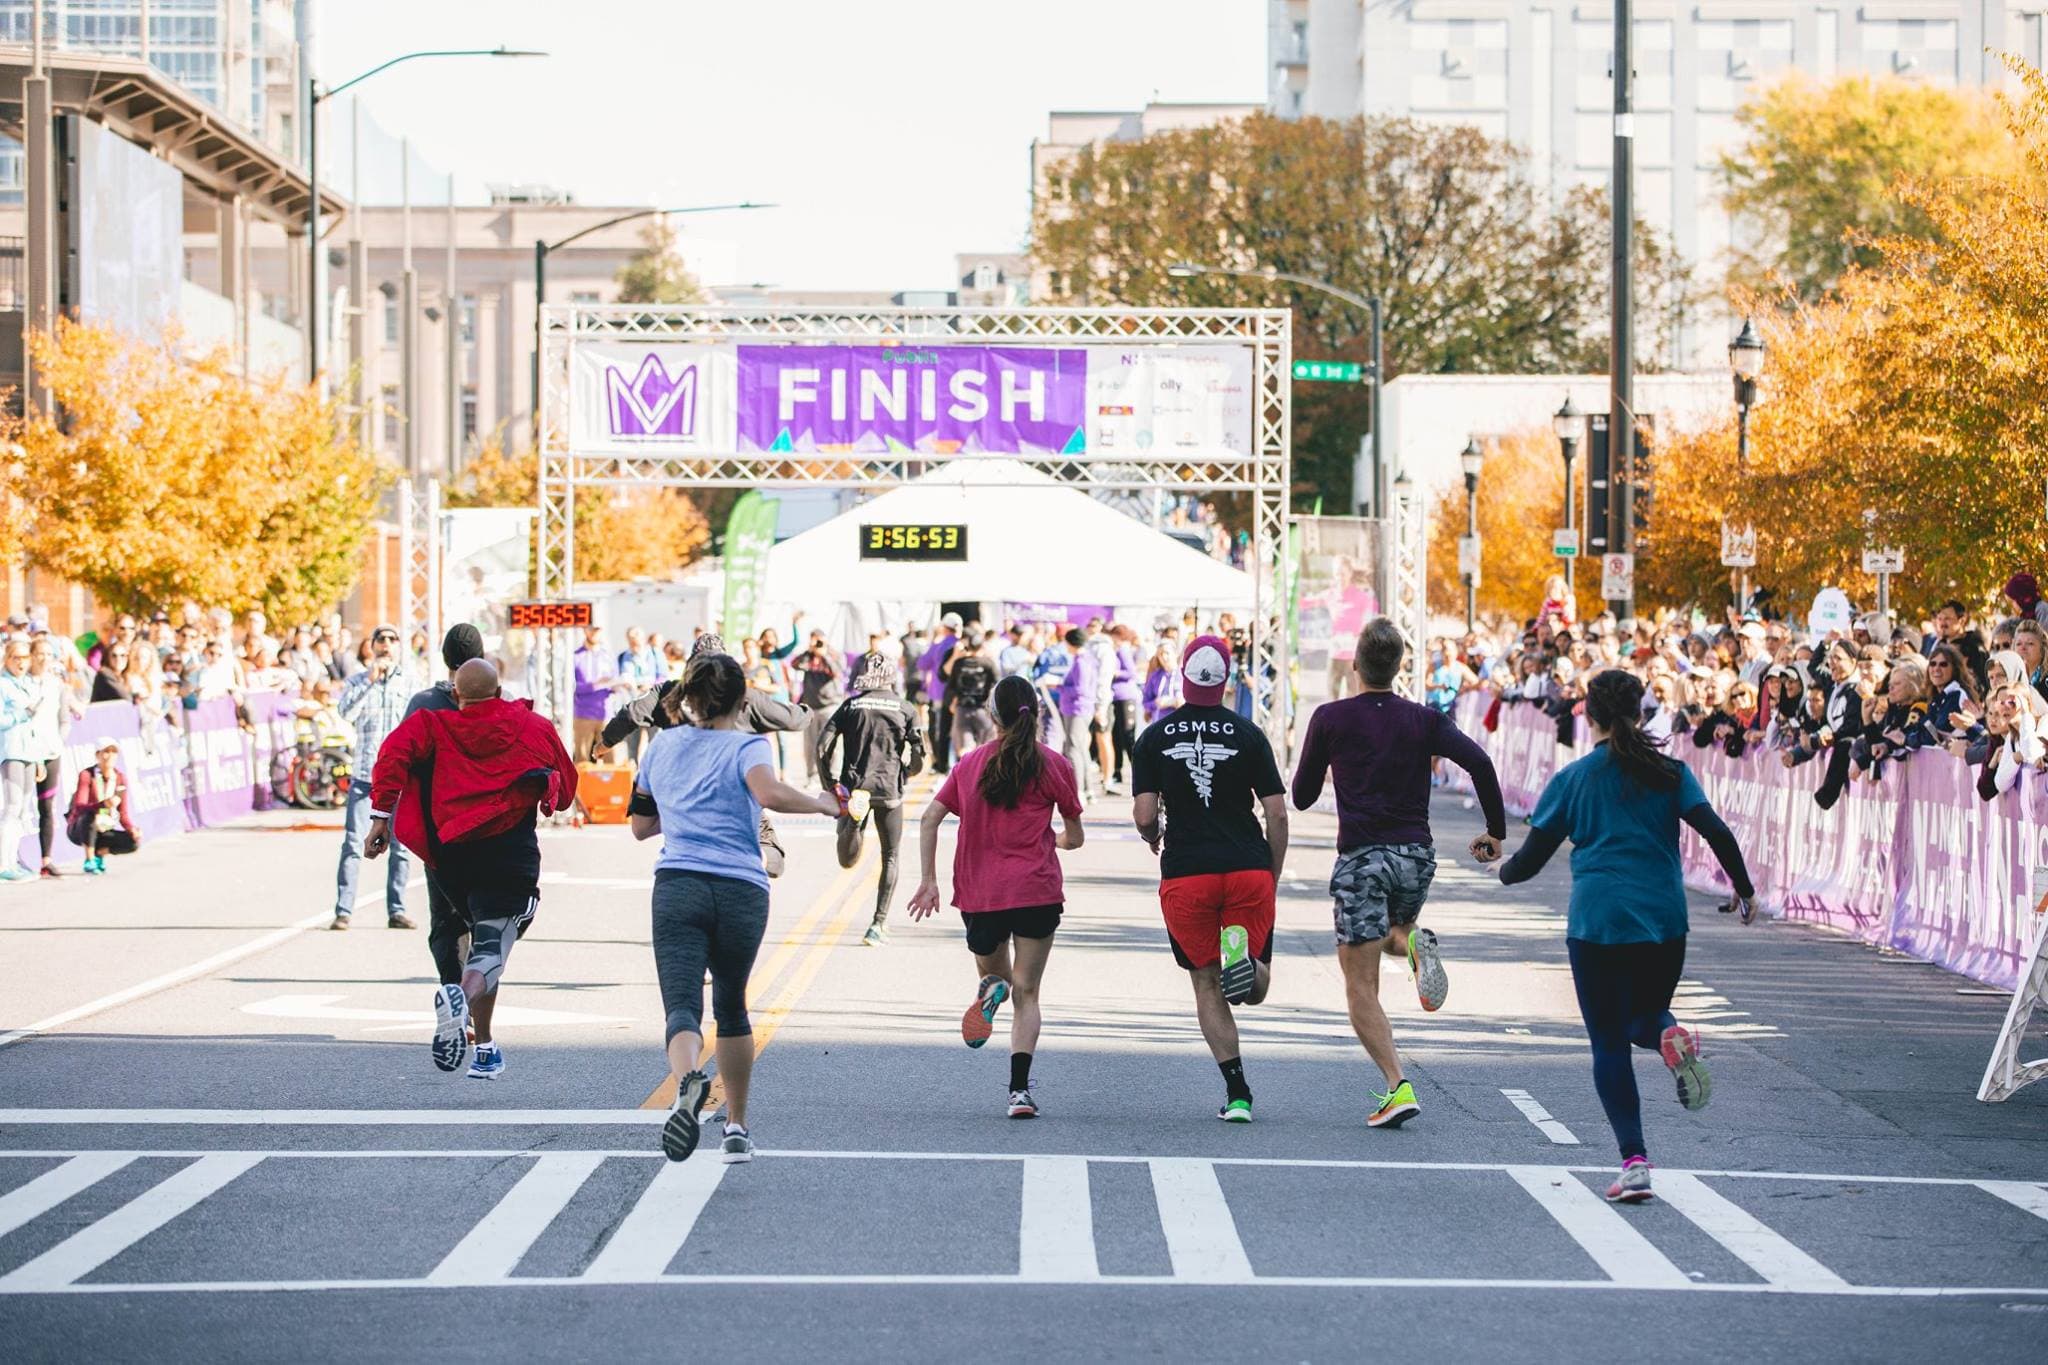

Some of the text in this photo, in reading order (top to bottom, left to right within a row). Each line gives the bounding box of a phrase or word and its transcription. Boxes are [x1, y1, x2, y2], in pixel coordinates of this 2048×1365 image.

[779, 368, 1045, 422] FINISH
[511, 604, 591, 629] 3:56:53
[1164, 721, 1235, 735] GSMSG
